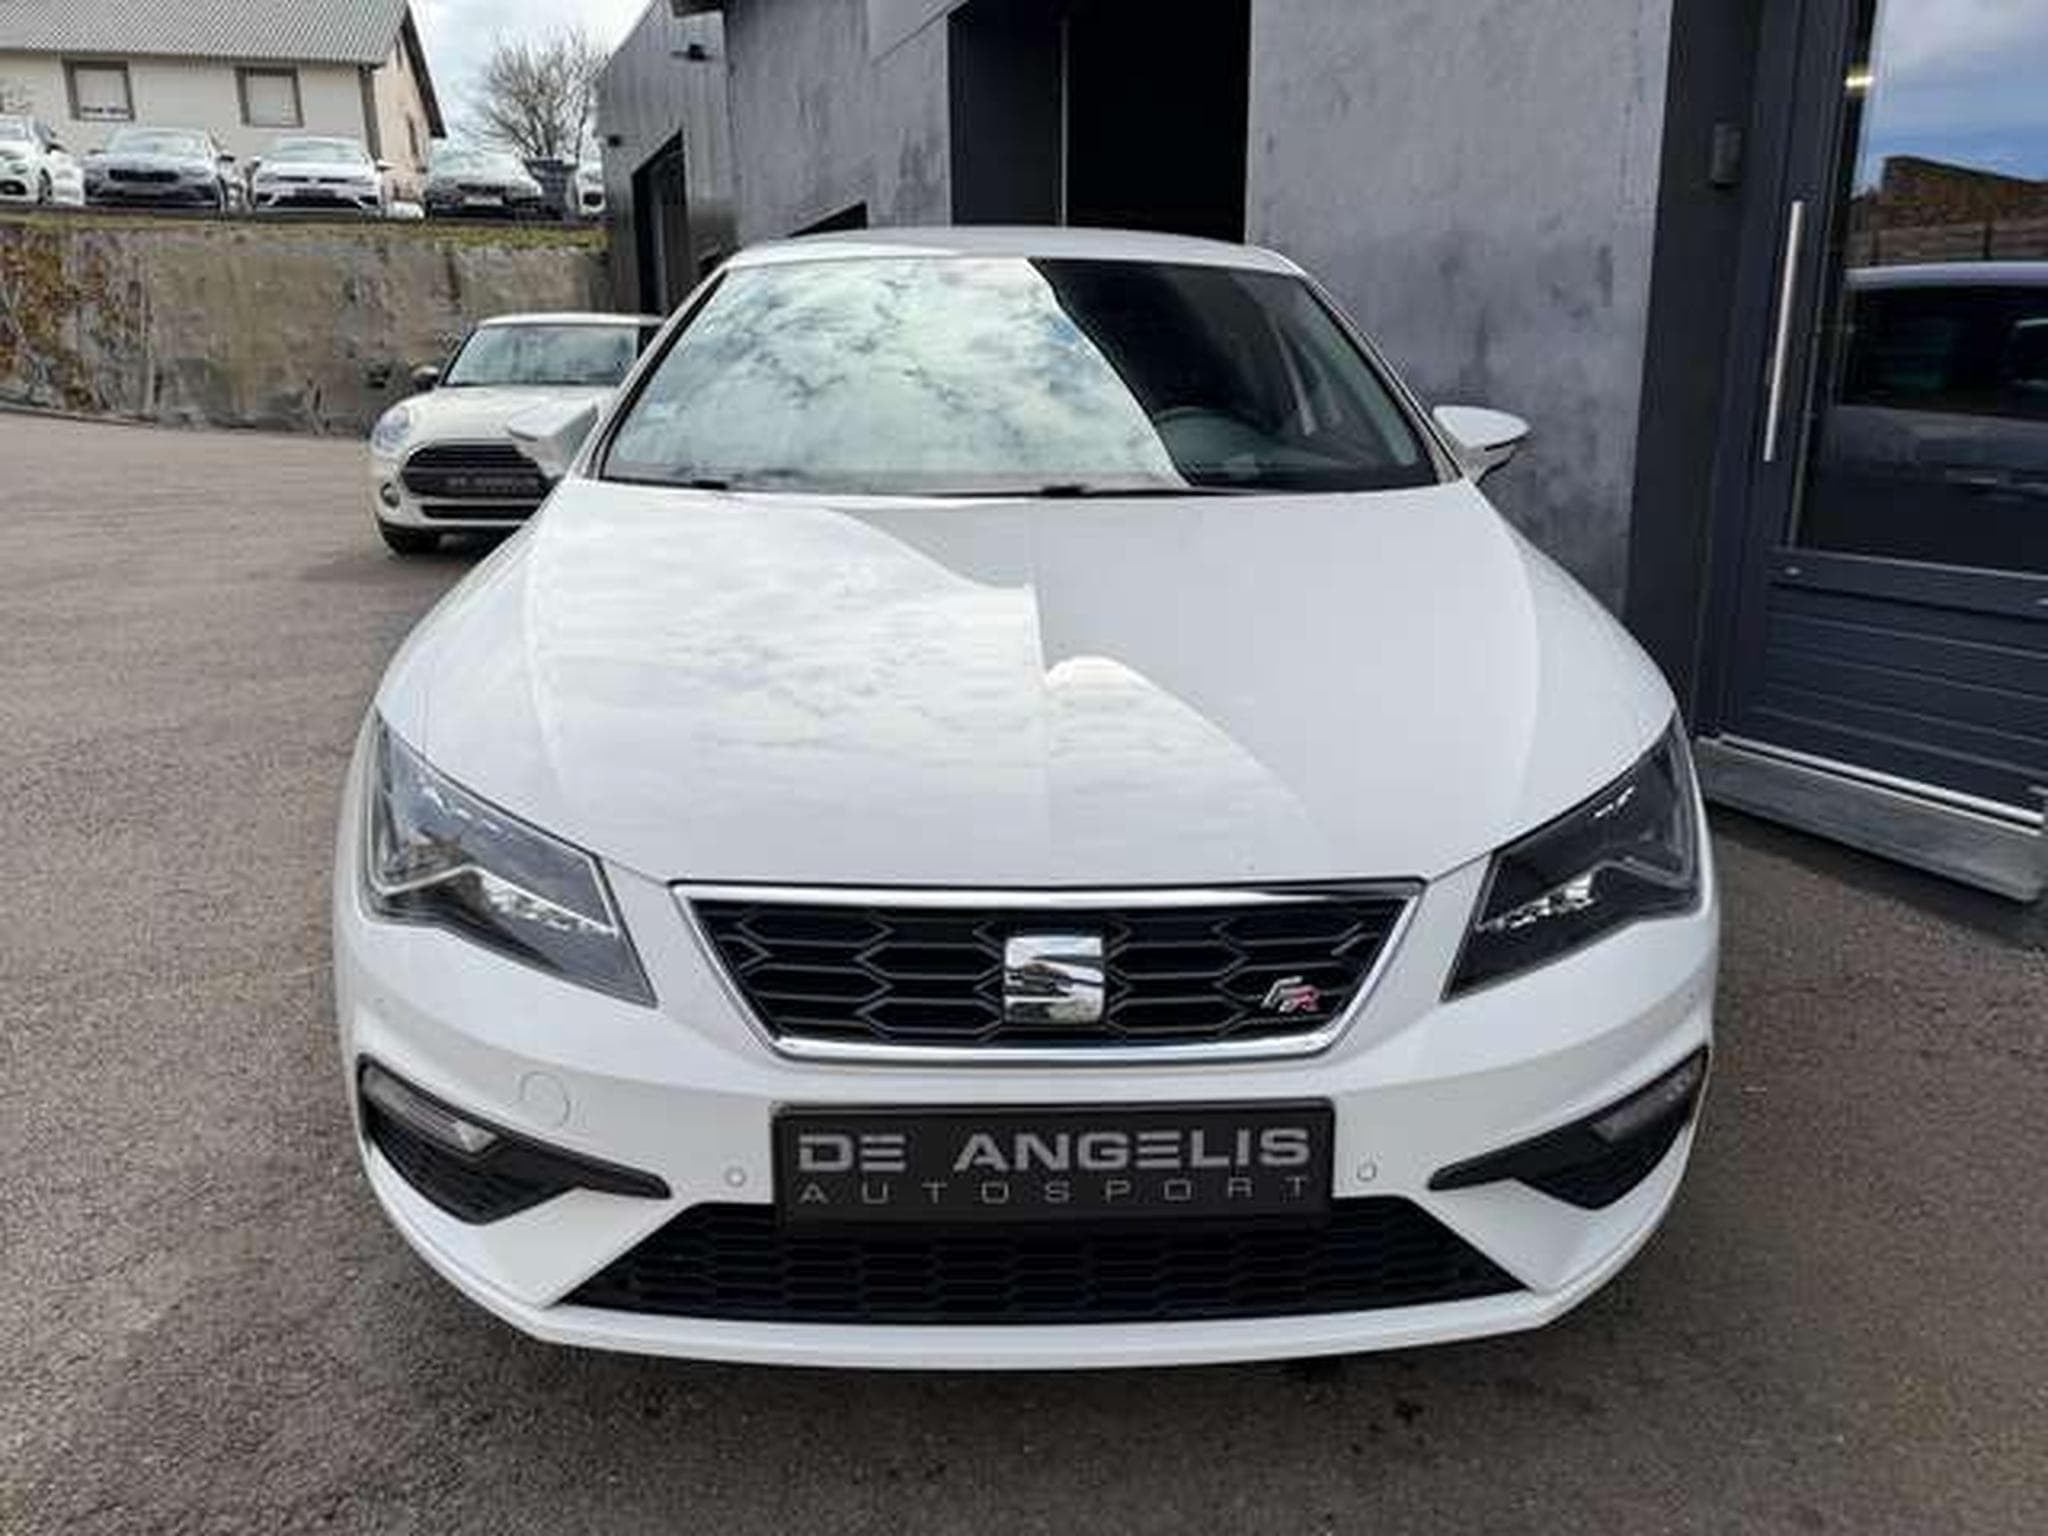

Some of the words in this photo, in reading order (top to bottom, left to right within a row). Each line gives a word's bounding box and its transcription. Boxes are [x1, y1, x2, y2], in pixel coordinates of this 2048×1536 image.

[799, 1133, 906, 1172] DE
[953, 1128, 1311, 1171] ANGELIS
[800, 1177, 1308, 1204] AUTOSPORT
